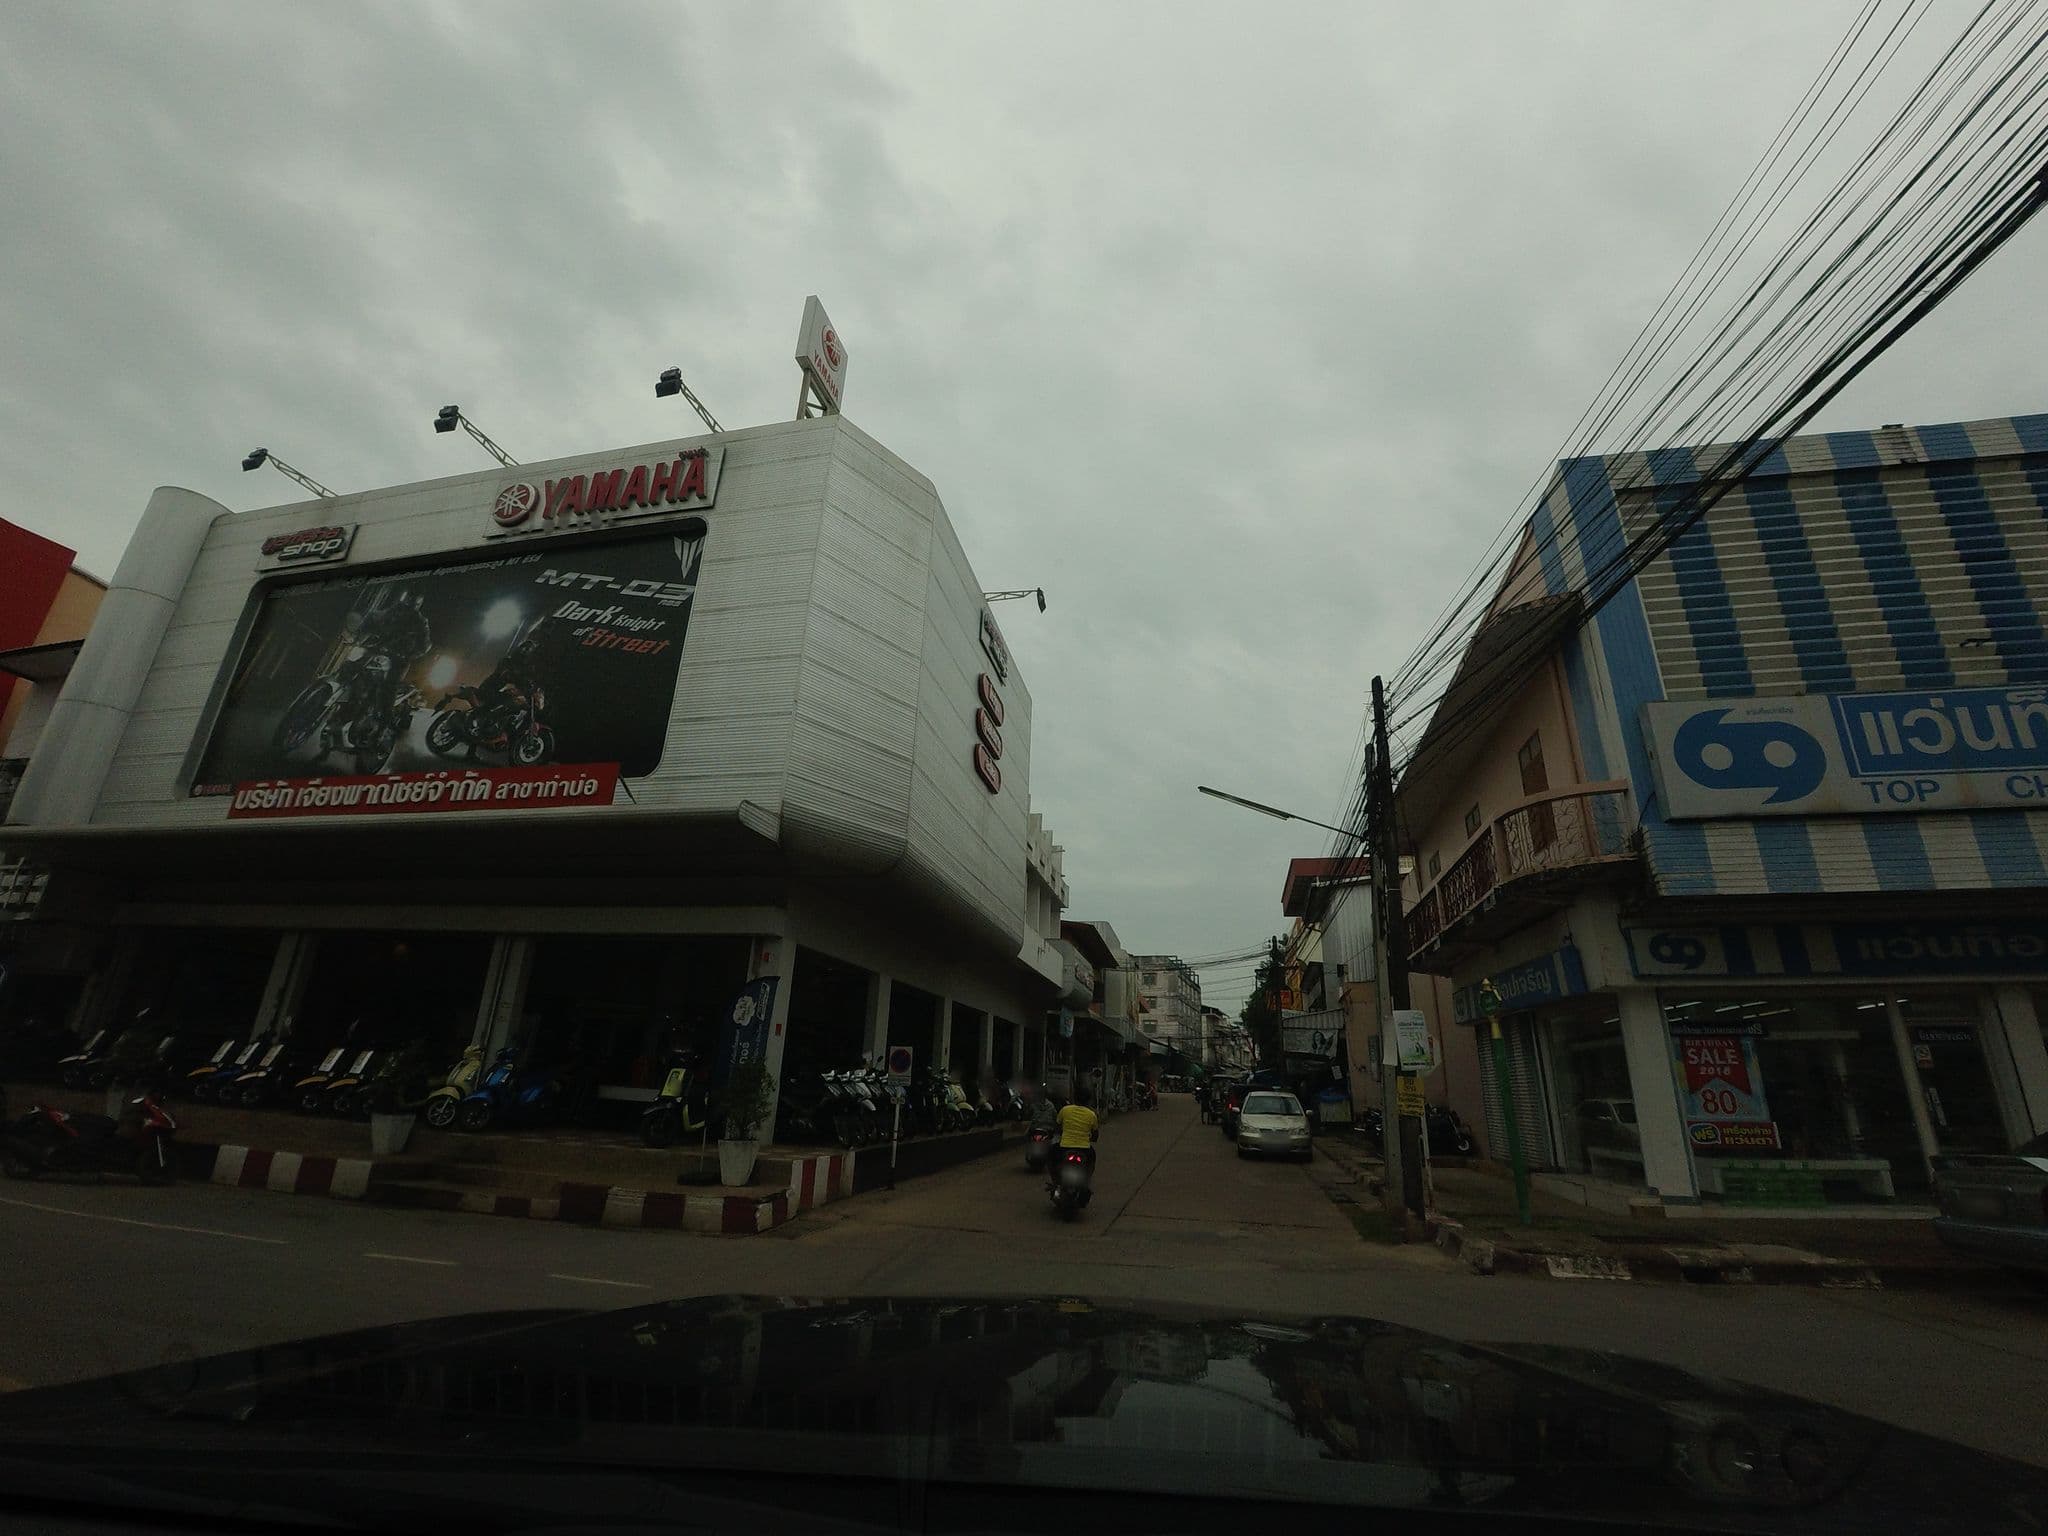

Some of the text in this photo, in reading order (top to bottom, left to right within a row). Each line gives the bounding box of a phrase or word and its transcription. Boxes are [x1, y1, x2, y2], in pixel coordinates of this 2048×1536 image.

[813, 349, 839, 402] YAMAHA
[542, 457, 707, 520] YAMAHA
[279, 538, 344, 560] shop
[534, 568, 697, 601] MT-03
[581, 627, 671, 656] Street
[234, 780, 294, 810] บริษัท
[495, 773, 599, 800] สาขาท่าบ่อ
[1862, 779, 1941, 804] TOP
[1687, 1047, 1740, 1065] SALE
[1702, 1088, 1737, 1115] 80
